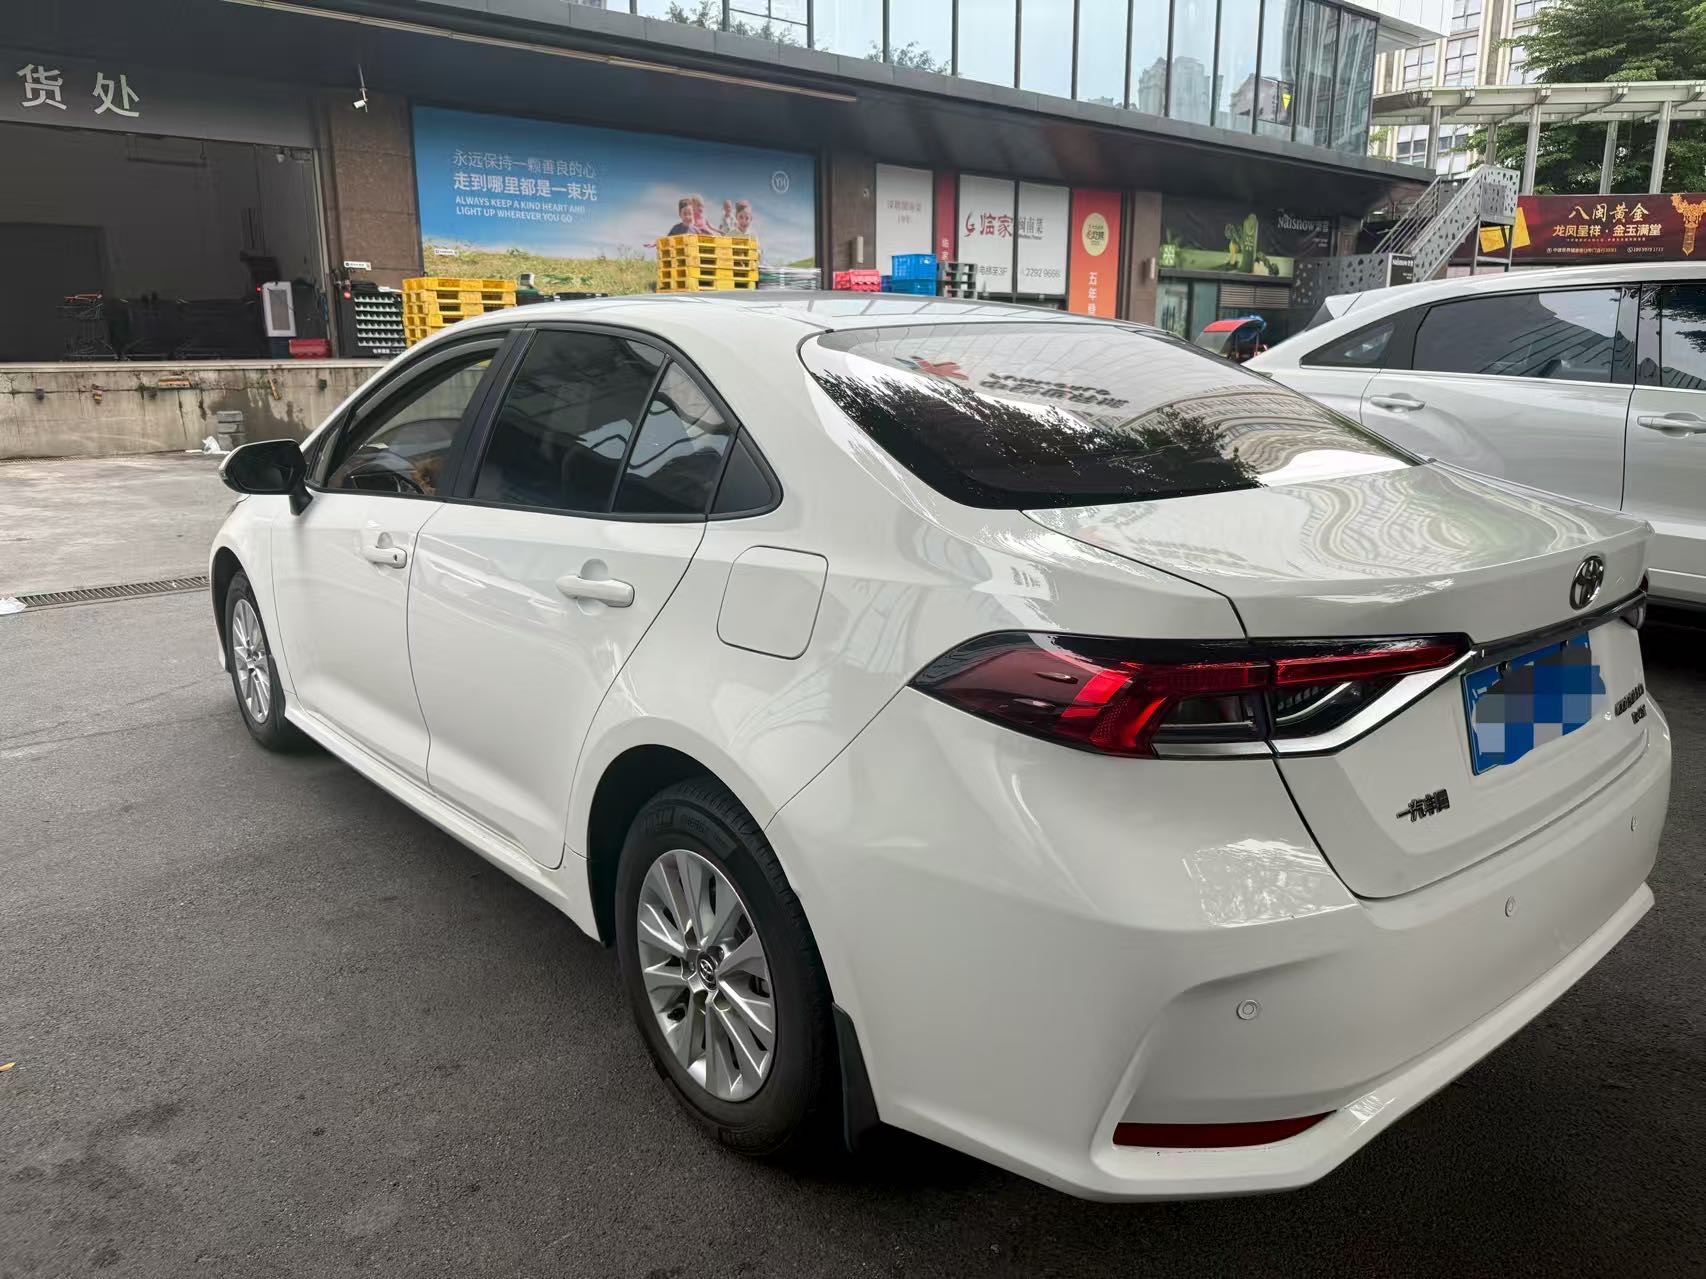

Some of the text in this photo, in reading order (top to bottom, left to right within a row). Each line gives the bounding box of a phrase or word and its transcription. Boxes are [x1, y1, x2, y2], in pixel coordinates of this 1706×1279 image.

[16, 63, 141, 118] 货处
[453, 148, 597, 179] 永远保持一颗善良的心
[453, 171, 598, 202] 走到哪里都是一束光
[455, 195, 586, 214] ALWAYS KEEP A KIND HEART AND
[456, 206, 573, 224] LIGHT UP WHEREVER YOU GO
[1568, 202, 1650, 223] 八闽黄金
